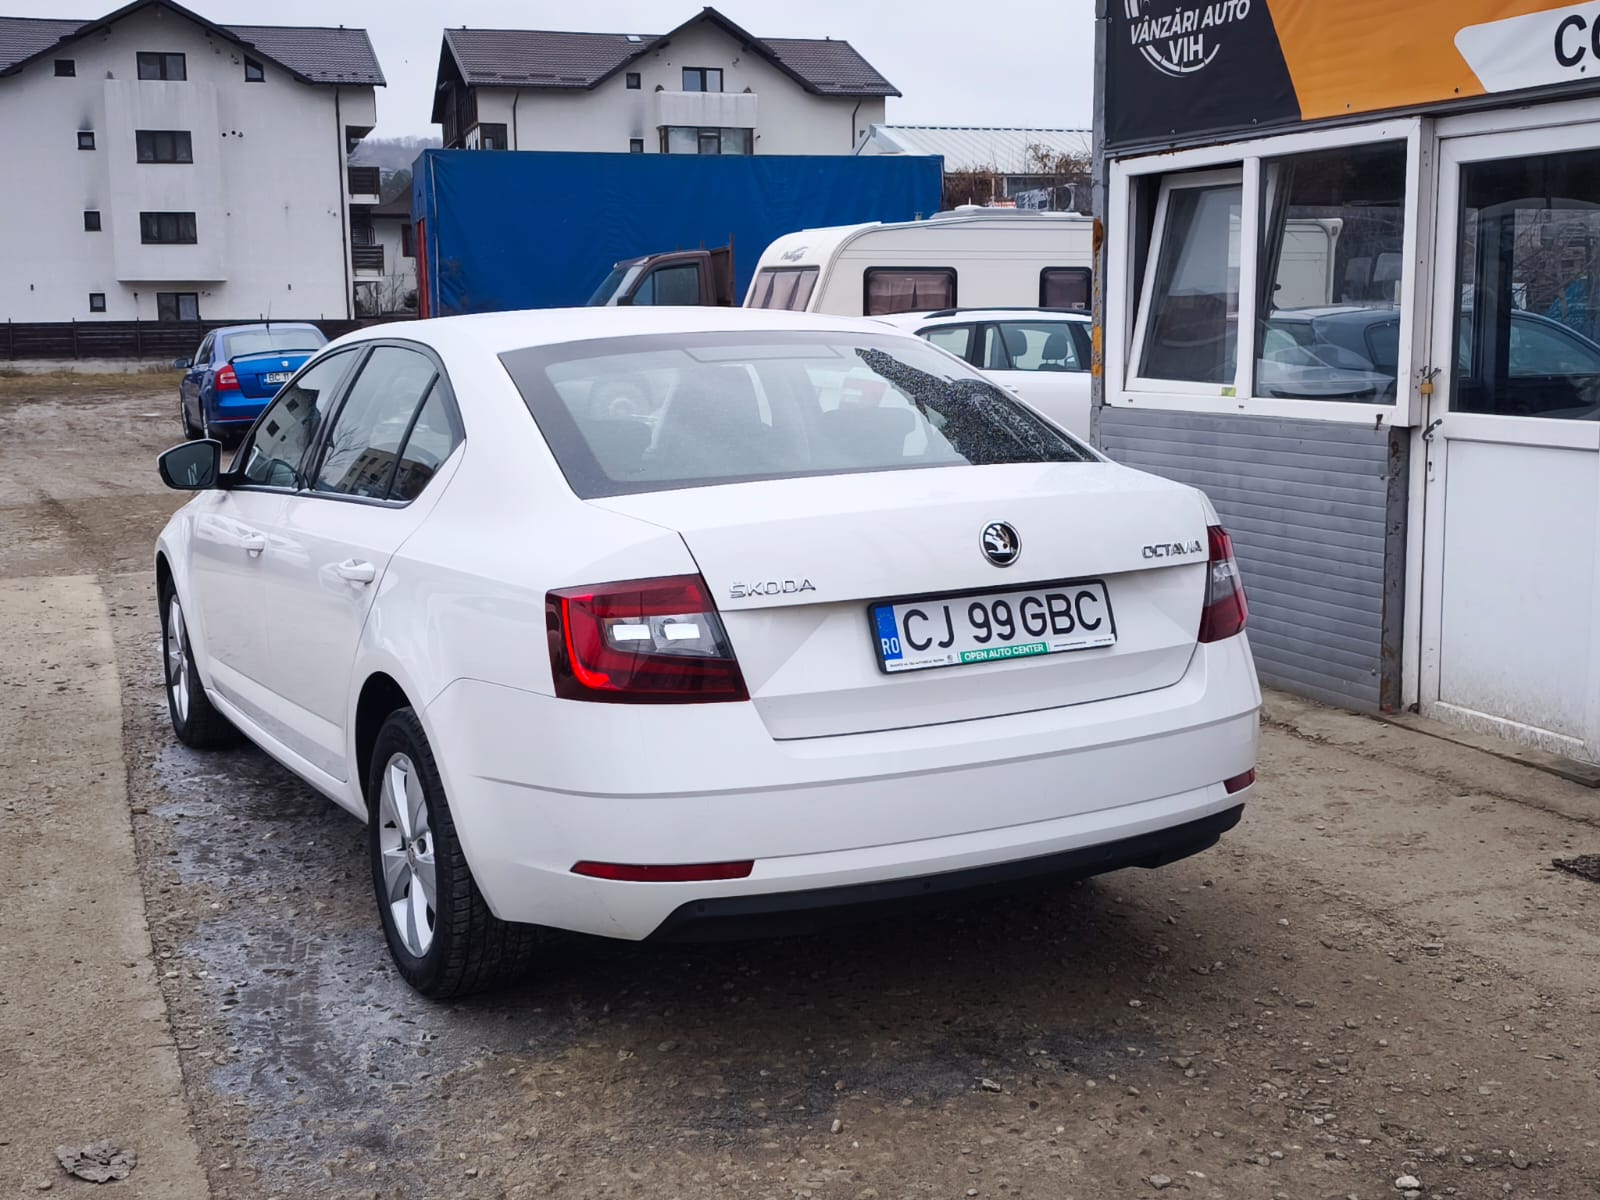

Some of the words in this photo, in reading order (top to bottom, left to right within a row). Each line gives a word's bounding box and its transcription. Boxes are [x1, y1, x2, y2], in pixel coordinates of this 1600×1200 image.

[1131, 7, 1199, 45] VÂNZĂRI
[1201, 0, 1250, 28] AUTO
[1168, 34, 1203, 64] VIH
[1554, 14, 1600, 67] C
[1142, 540, 1202, 558] OCTAVIA
[903, 605, 955, 651] CJ
[881, 637, 900, 655] RO
[964, 650, 988, 661] OPEN
[988, 646, 1012, 658] AUTO
[1012, 643, 1044, 656] CENTER
